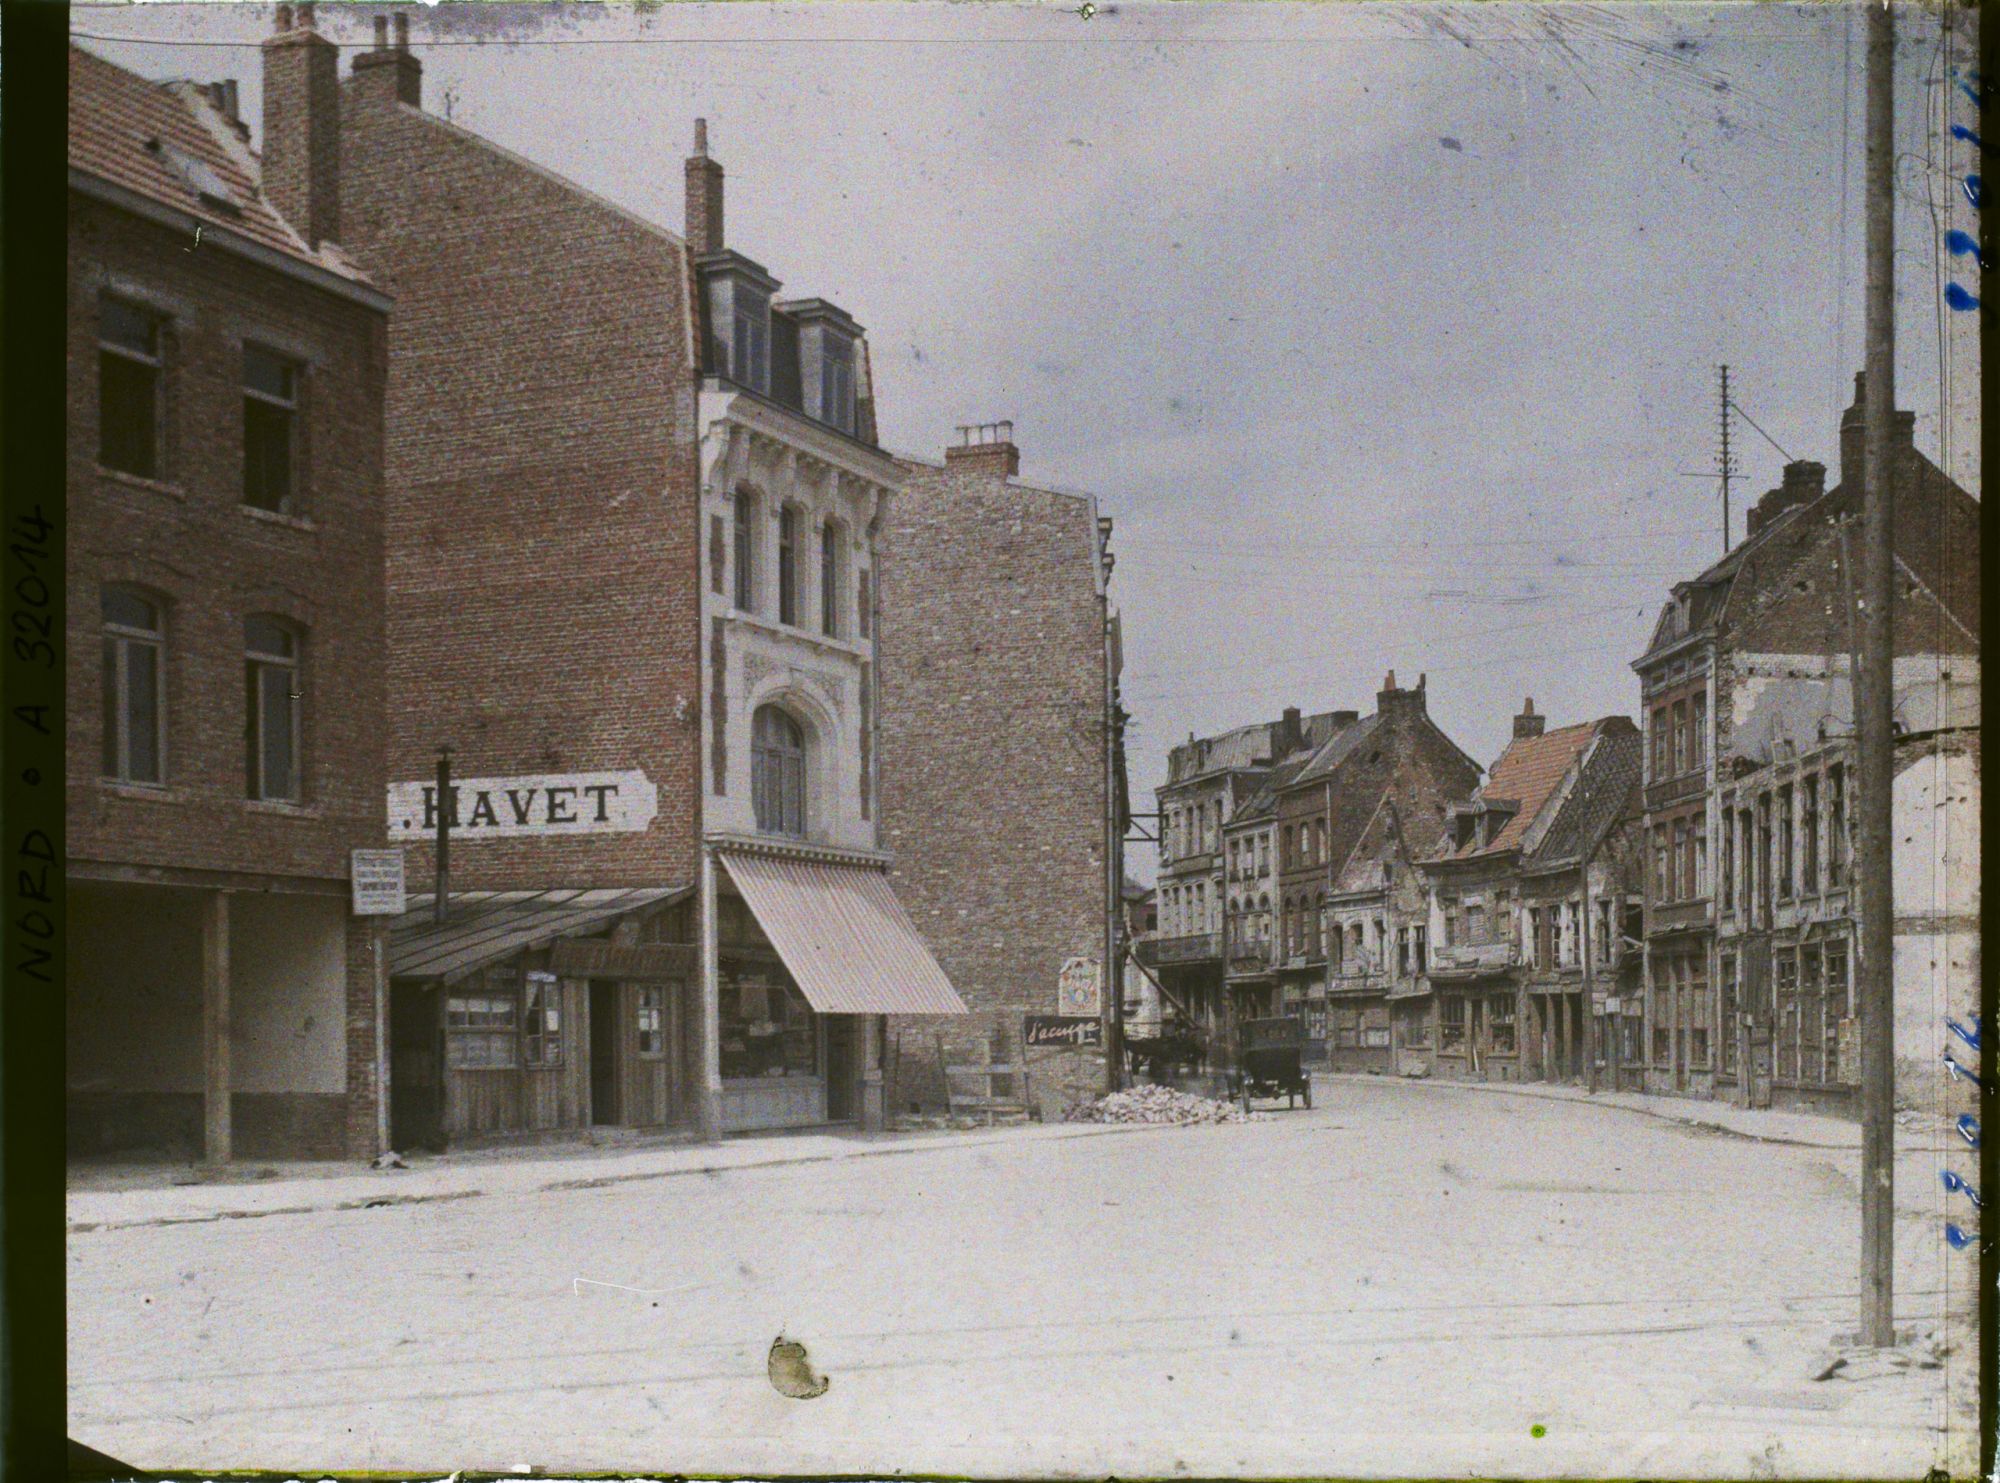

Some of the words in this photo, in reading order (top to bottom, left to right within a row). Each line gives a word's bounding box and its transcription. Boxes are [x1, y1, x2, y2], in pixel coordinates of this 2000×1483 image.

[10, 503, 56, 669] 32014
[12, 704, 51, 736] A
[16, 828, 58, 985] NORD
